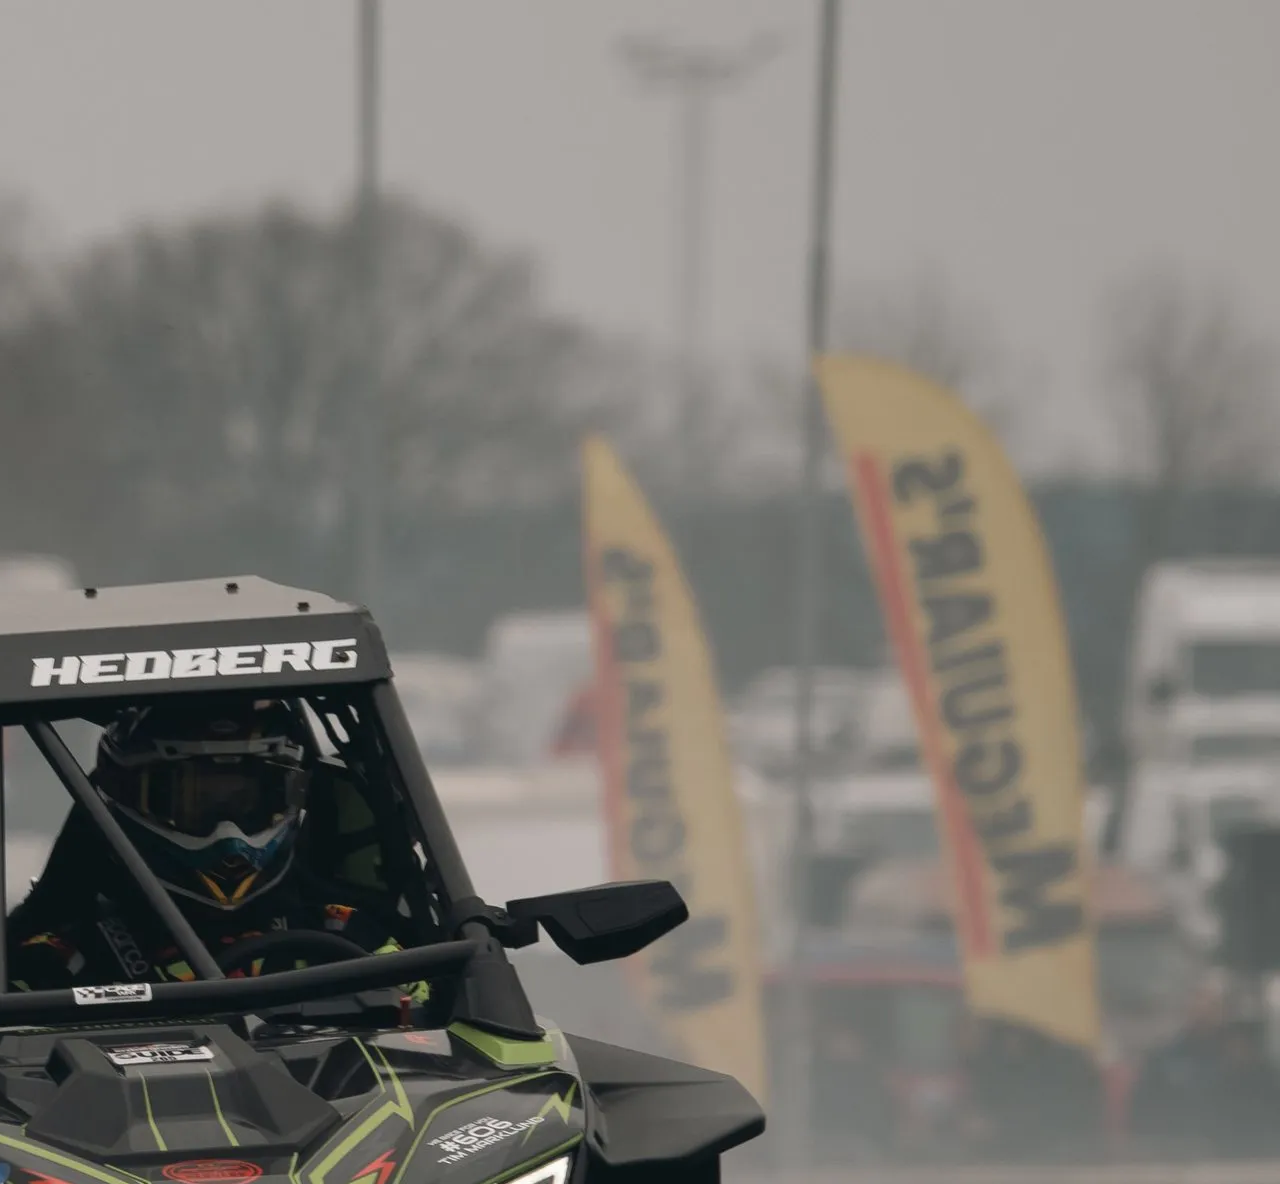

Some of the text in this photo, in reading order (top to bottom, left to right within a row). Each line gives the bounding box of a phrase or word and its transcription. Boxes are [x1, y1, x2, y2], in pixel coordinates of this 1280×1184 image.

[30, 638, 358, 688] HEDBERG
[437, 1116, 545, 1165] TIM MARKLUND
[439, 1118, 513, 1153] #606
